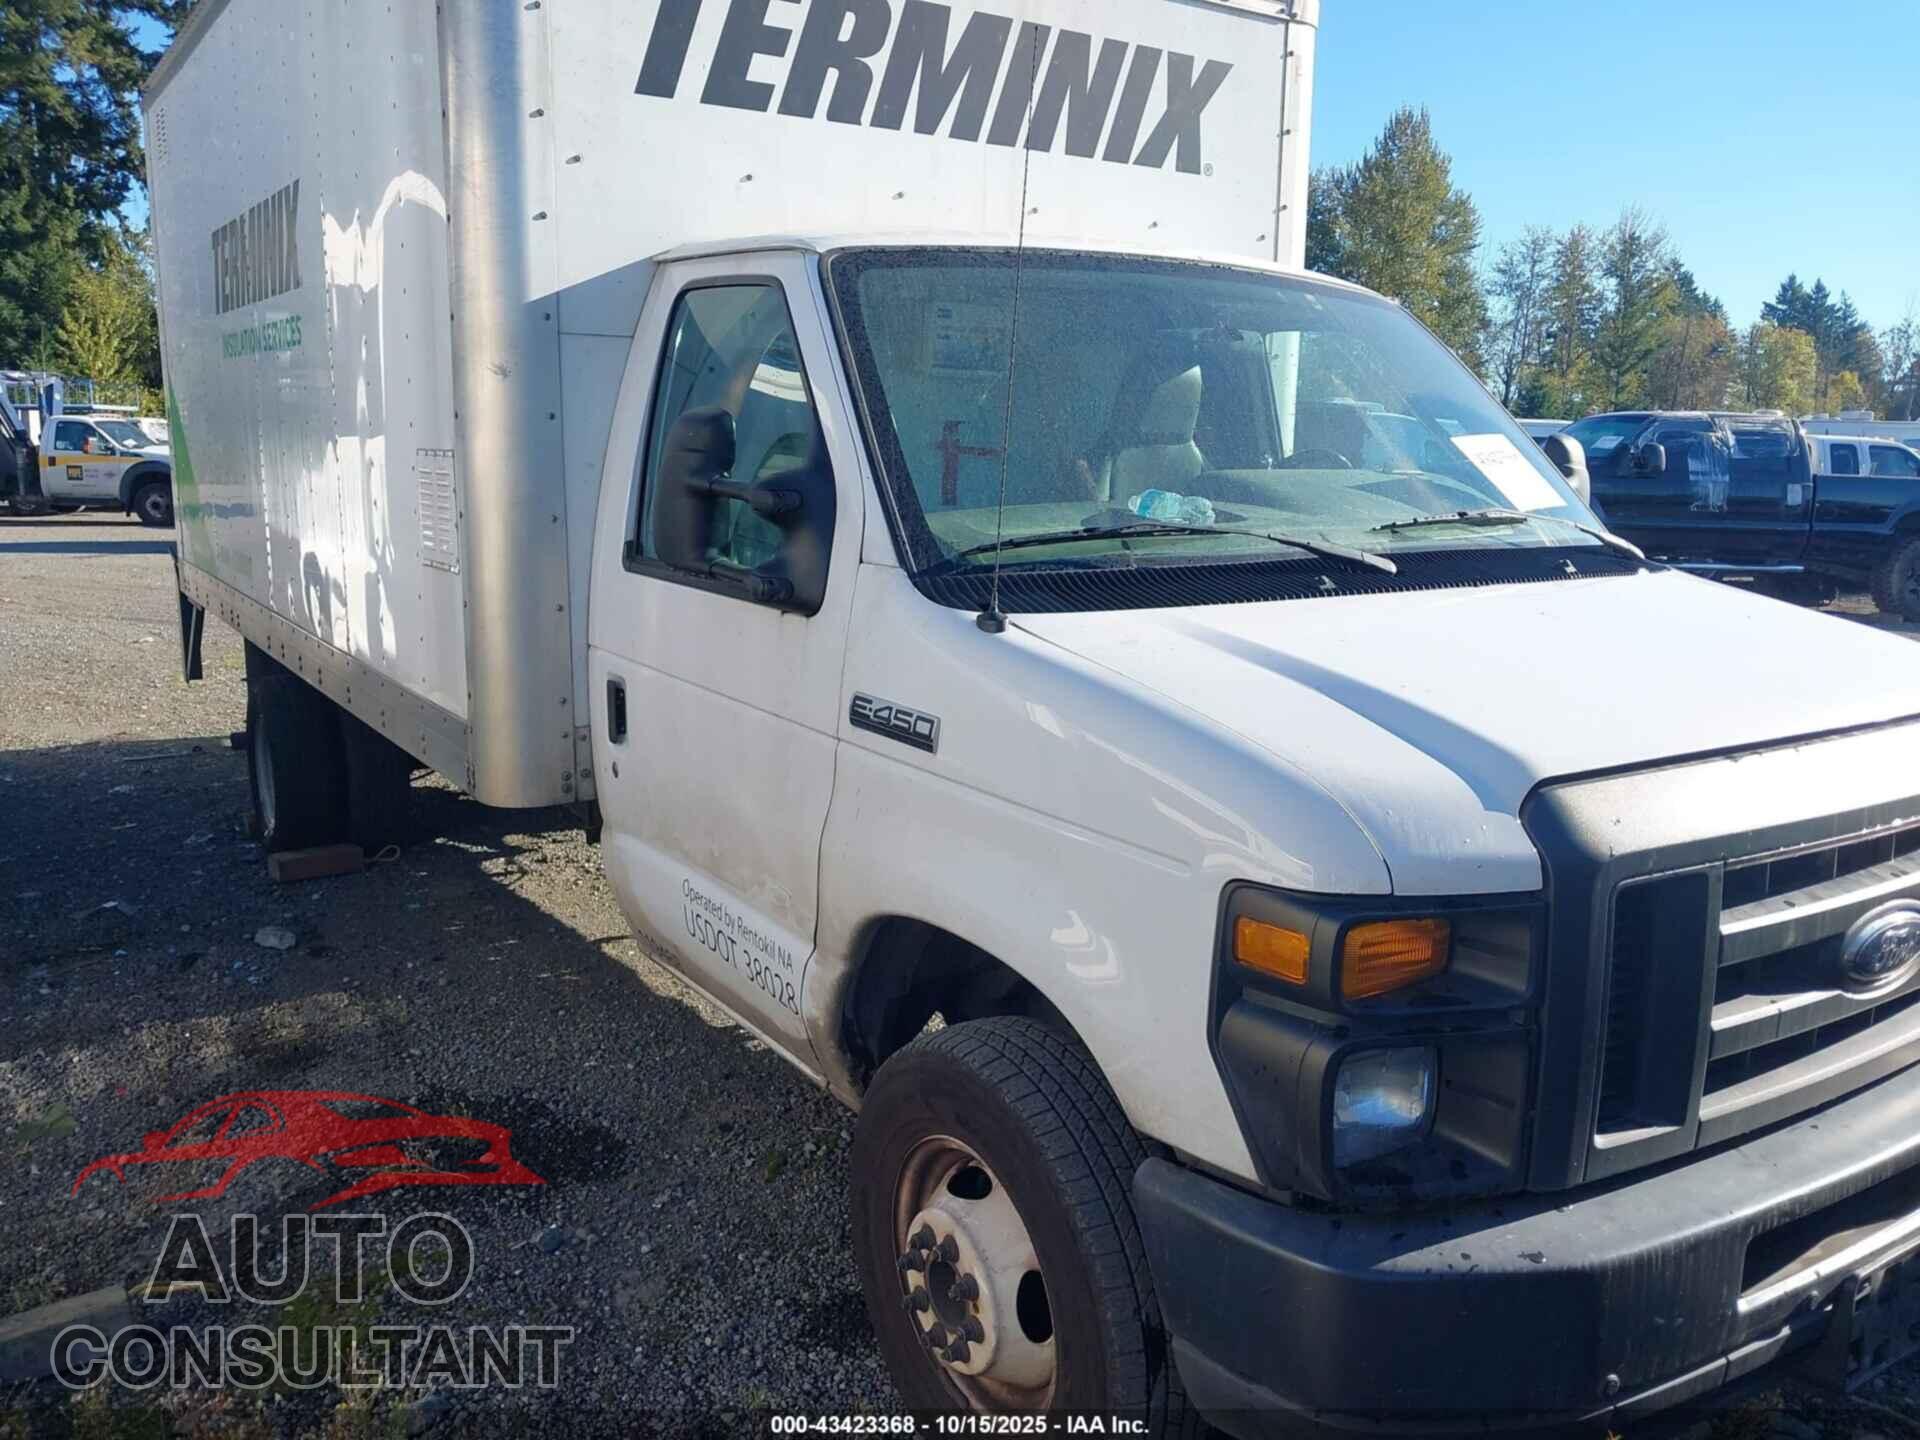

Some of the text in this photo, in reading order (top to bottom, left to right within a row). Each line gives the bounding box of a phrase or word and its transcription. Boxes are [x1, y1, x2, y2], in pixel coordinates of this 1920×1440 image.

[211, 178, 301, 315] TERMINIX
[263, 315, 302, 351] SERVICES
[850, 695, 935, 739] E-450
[682, 878, 794, 975] Operated by Rentokil NA
[683, 904, 737, 969] USDOT
[743, 949, 799, 1015] 38028
